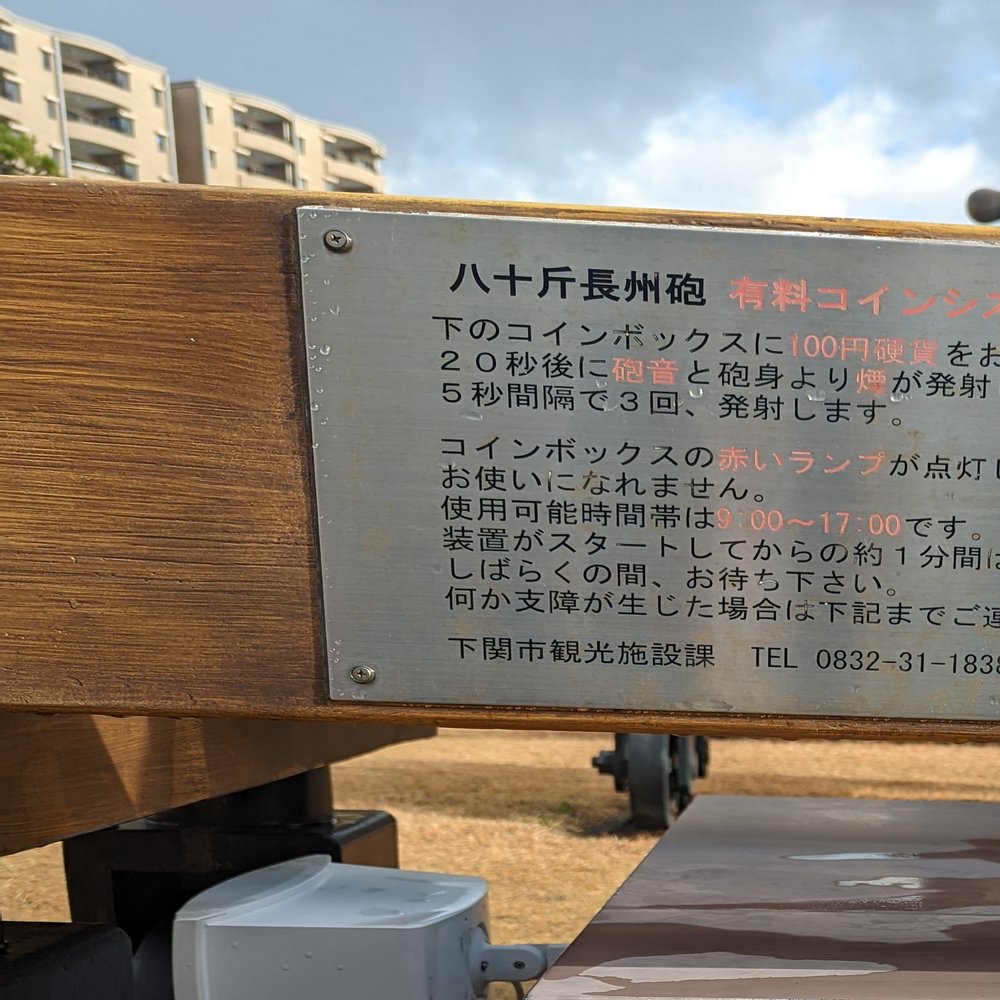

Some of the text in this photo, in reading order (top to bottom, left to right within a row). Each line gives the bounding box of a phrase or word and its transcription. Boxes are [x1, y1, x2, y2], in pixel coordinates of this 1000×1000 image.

[450, 263, 706, 306] 八十斤長州砲
[441, 465, 765, 502] お使いになれません。
[449, 557, 897, 597] しばらくの間、お待ち下さい。
[448, 637, 715, 668] 下関市観光施設課
[751, 647, 798, 669] TEL
